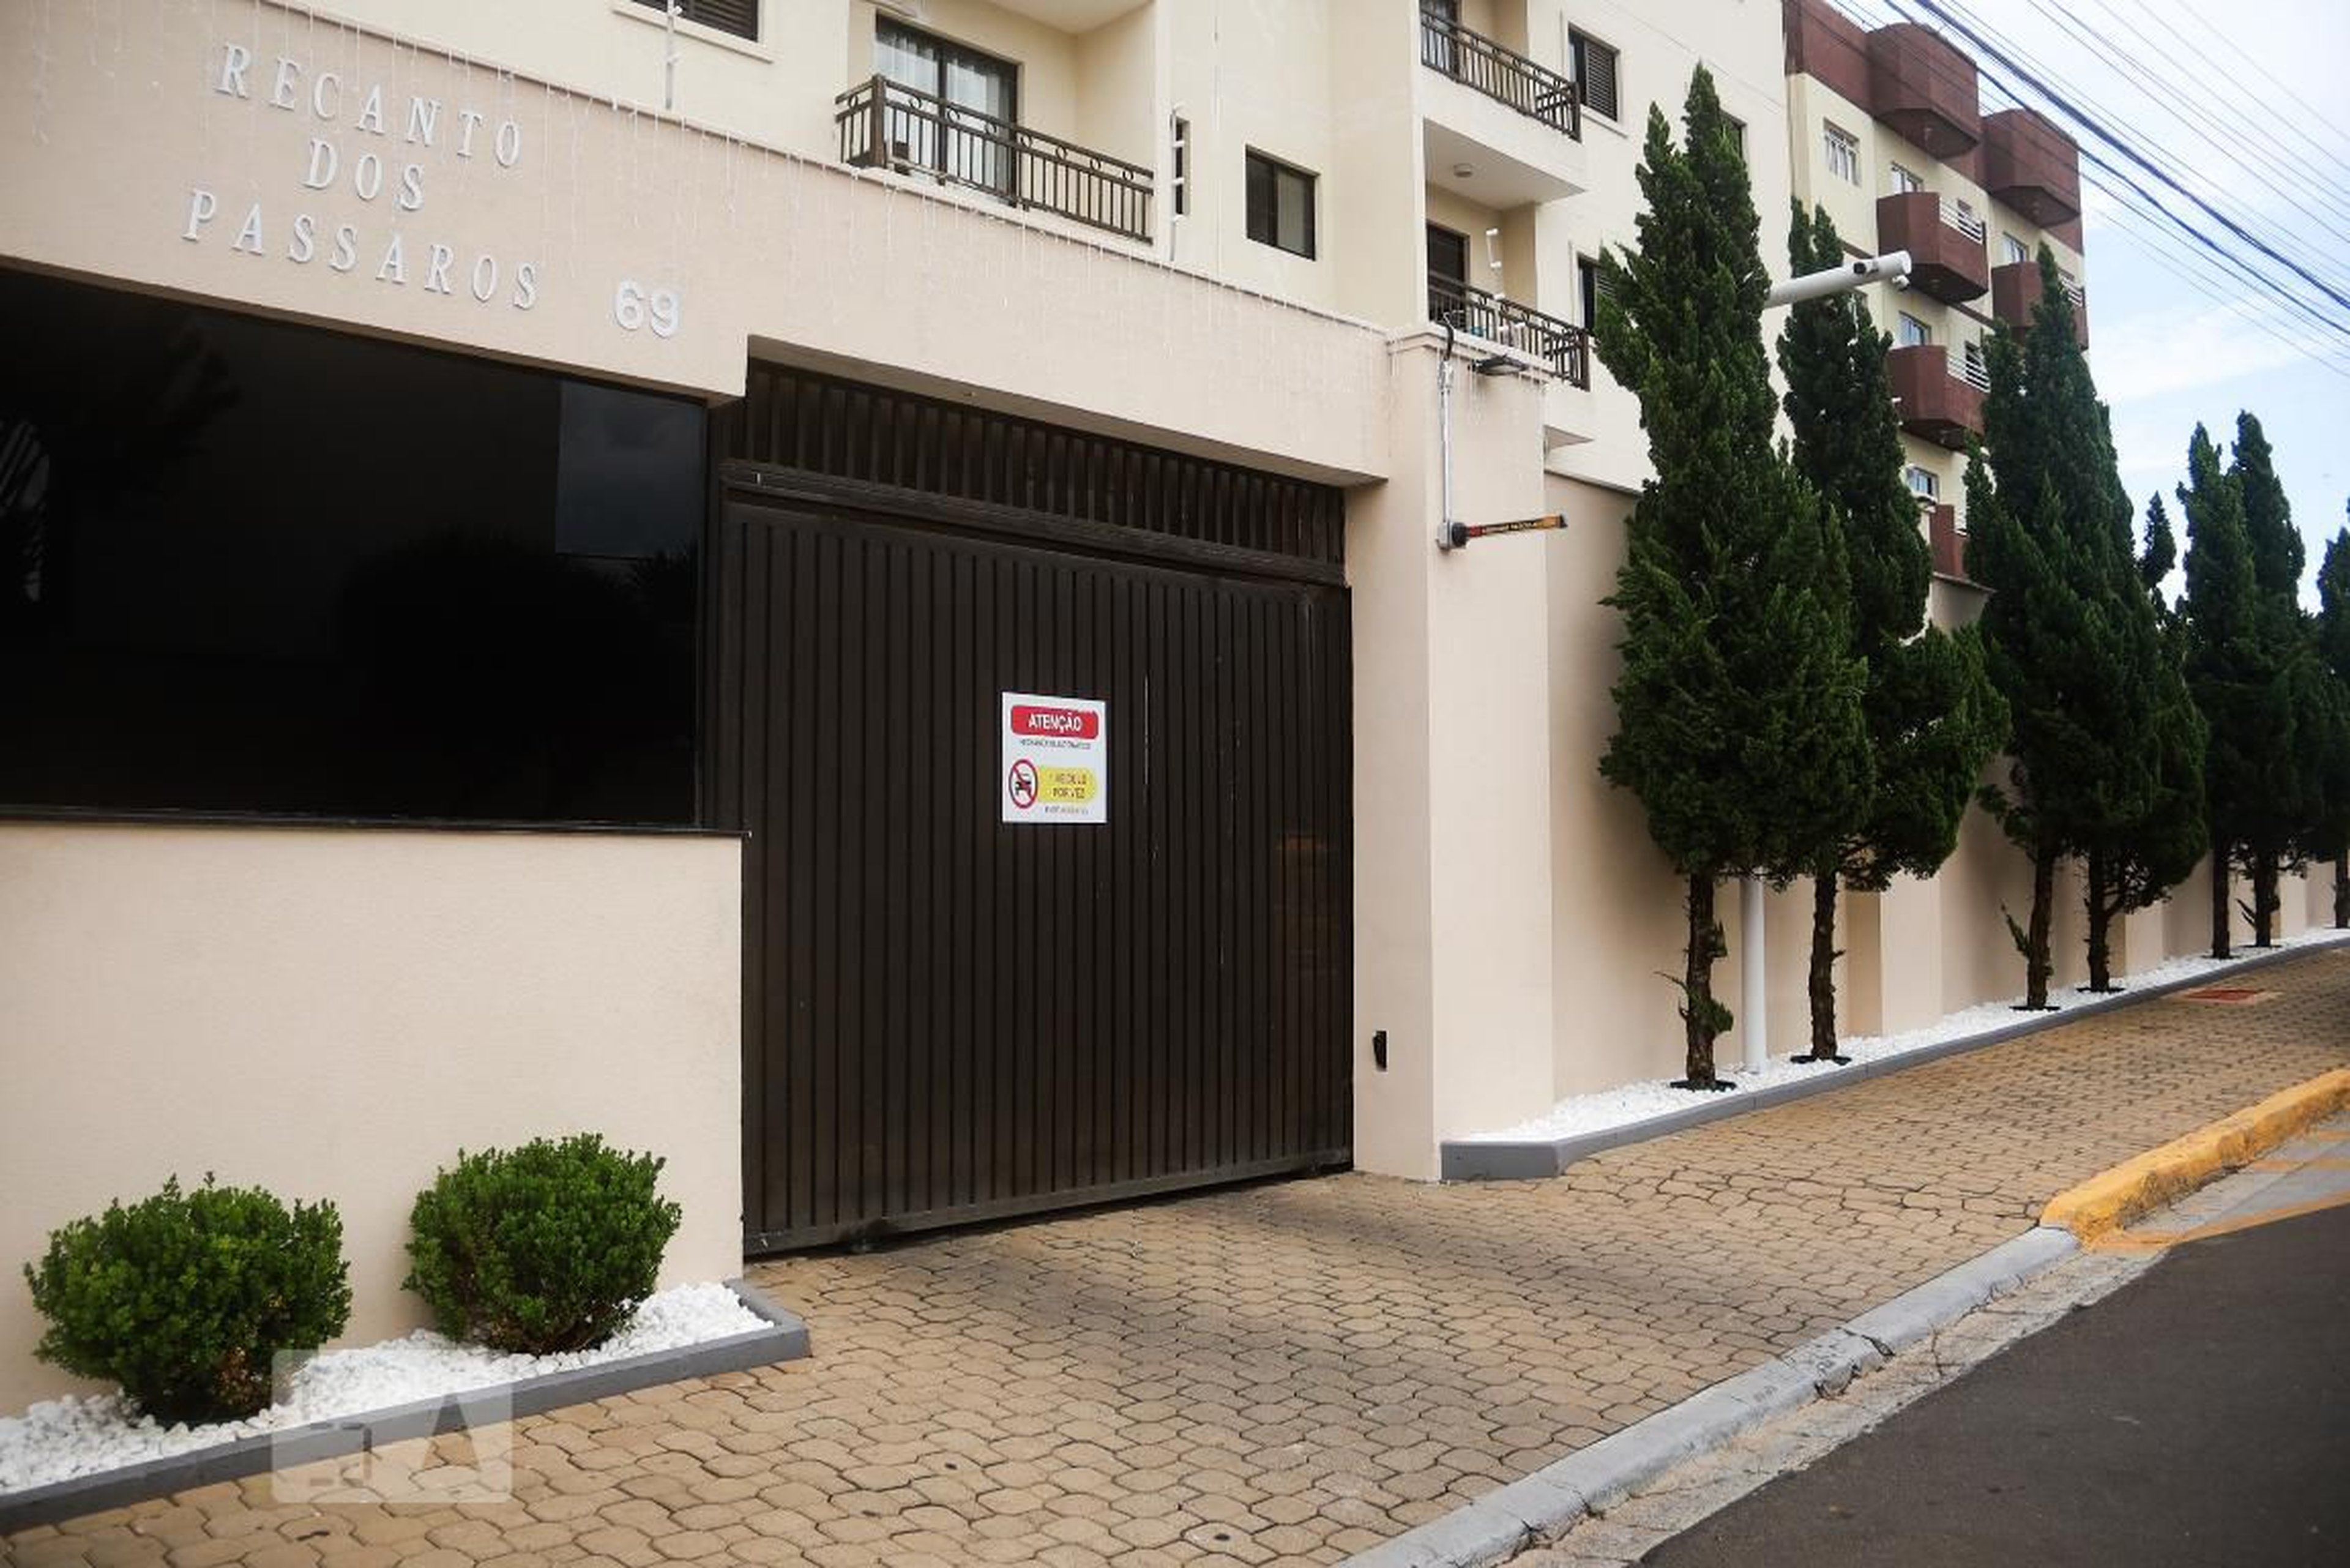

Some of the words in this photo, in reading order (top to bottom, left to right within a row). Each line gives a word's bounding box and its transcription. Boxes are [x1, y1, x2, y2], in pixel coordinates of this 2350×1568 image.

[215, 42, 523, 168] RECANTO
[301, 137, 426, 212] DOS
[181, 189, 539, 311] PASSAROS
[614, 278, 681, 339] 69
[1028, 712, 1084, 733] ATENÇÃO
